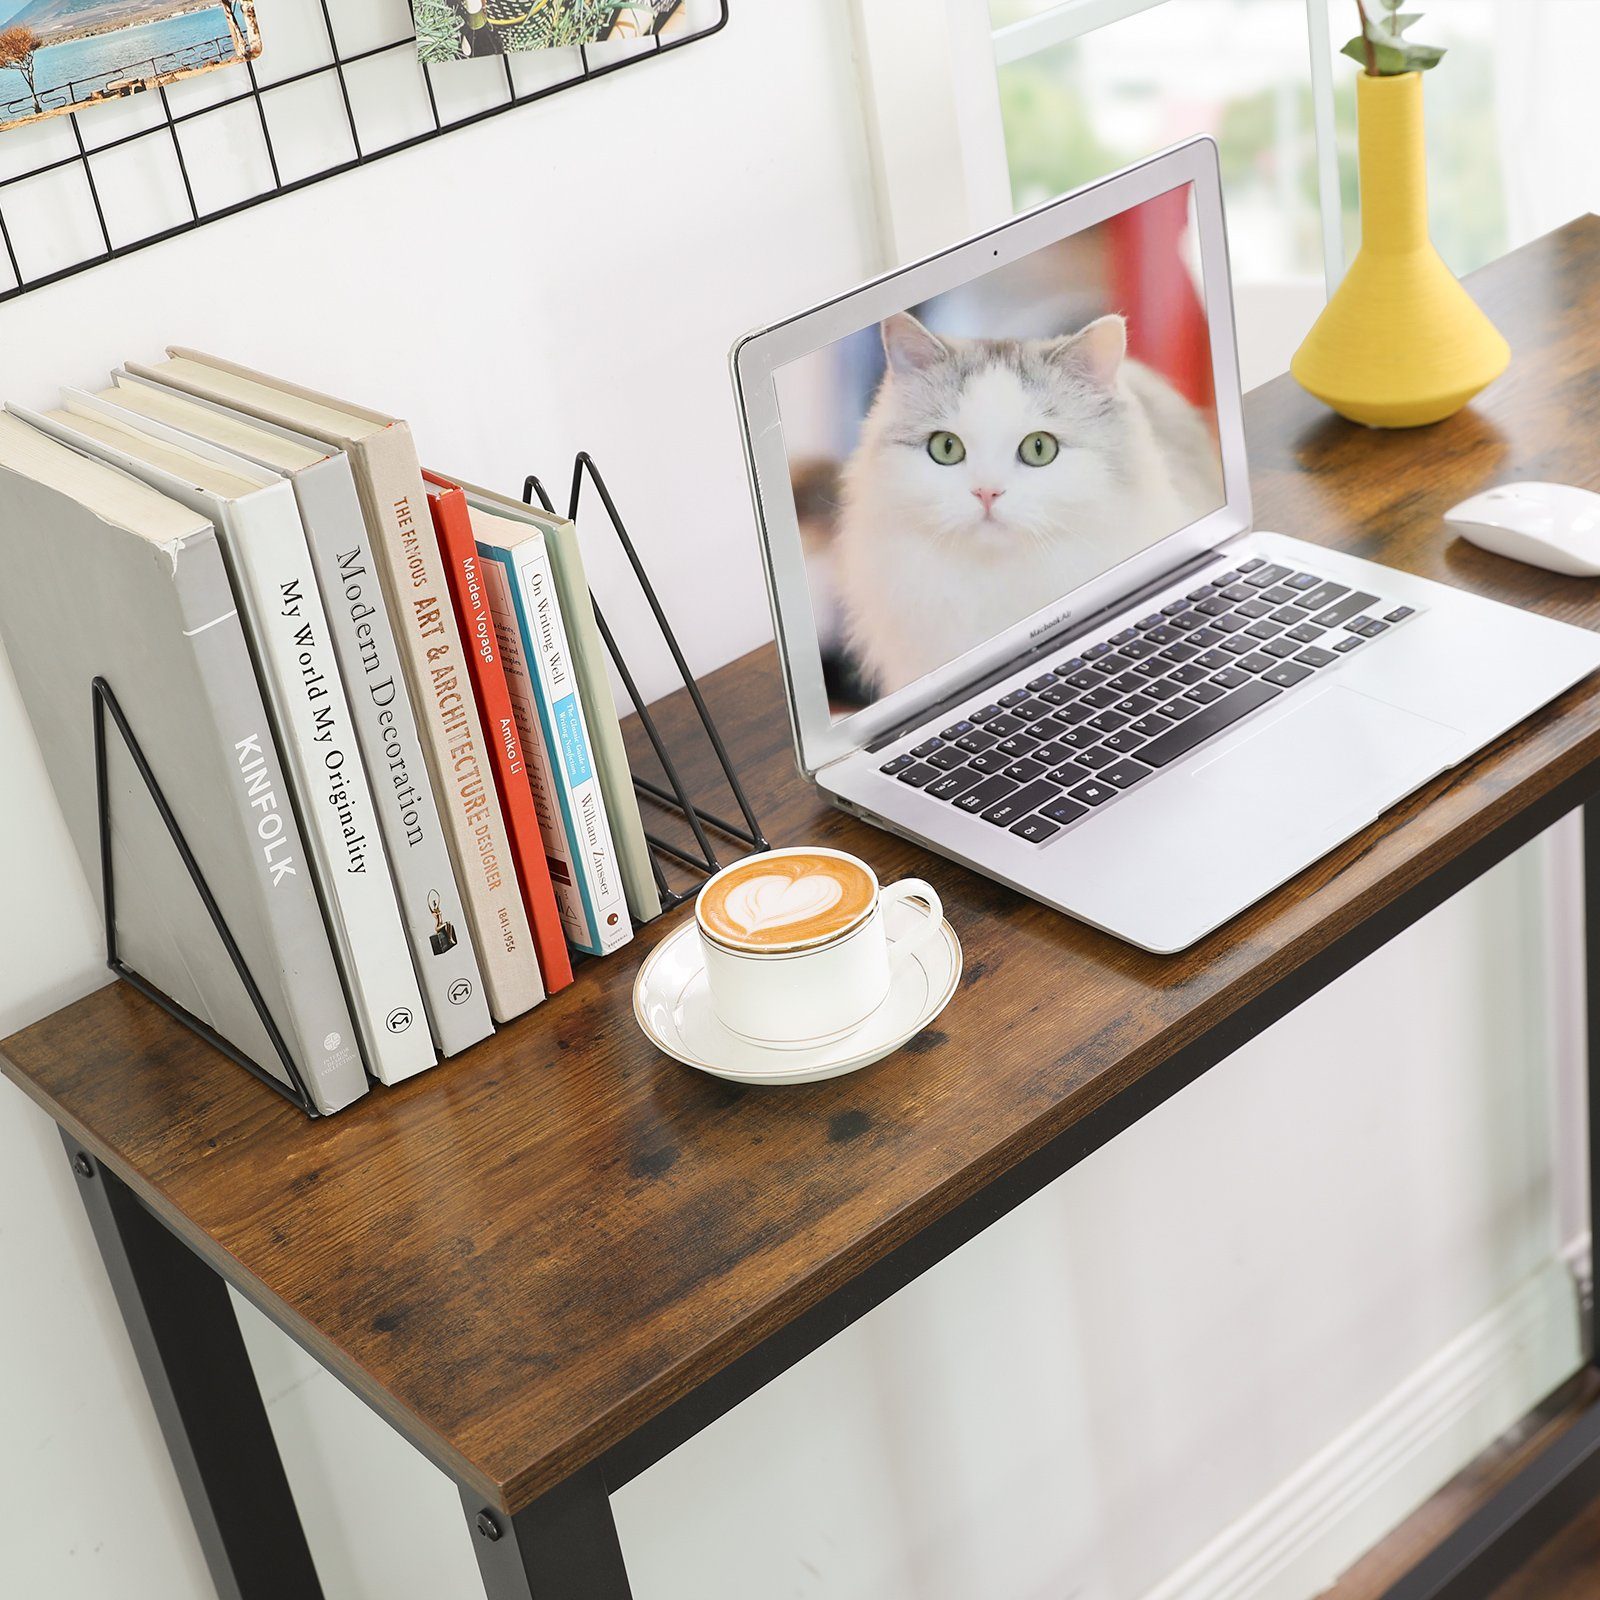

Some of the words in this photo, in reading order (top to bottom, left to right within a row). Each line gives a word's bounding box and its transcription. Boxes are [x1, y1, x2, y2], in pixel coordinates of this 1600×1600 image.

[394, 496, 412, 528] THE
[402, 529, 428, 588] FAMOUS
[414, 596, 444, 640] ART
[463, 557, 480, 610] Maiden
[476, 610, 494, 663] Voyage
[531, 573, 543, 596] On
[538, 598, 554, 653] Writing
[550, 652, 564, 685] Well
[426, 644, 449, 664] &
[280, 578, 303, 617] My
[294, 622, 328, 701] World
[313, 705, 335, 742] My
[325, 750, 366, 874] Originality
[336, 544, 376, 675] Modern
[370, 675, 424, 848] Decoration
[566, 703, 574, 718] The
[430, 665, 490, 827] ARCHITECTURE
[500, 718, 516, 760] Amiko
[510, 760, 522, 774] Li
[560, 712, 568, 739] Writing
[565, 738, 577, 775] Nonfiction
[1004, 740, 1016, 748] W
[1052, 770, 1064, 778] Z
[234, 733, 296, 887] KINFOLK
[474, 824, 502, 892] DESIGNER
[580, 793, 598, 846] William
[592, 848, 610, 896] Zinsser
[498, 908, 516, 953] 1841-1956
